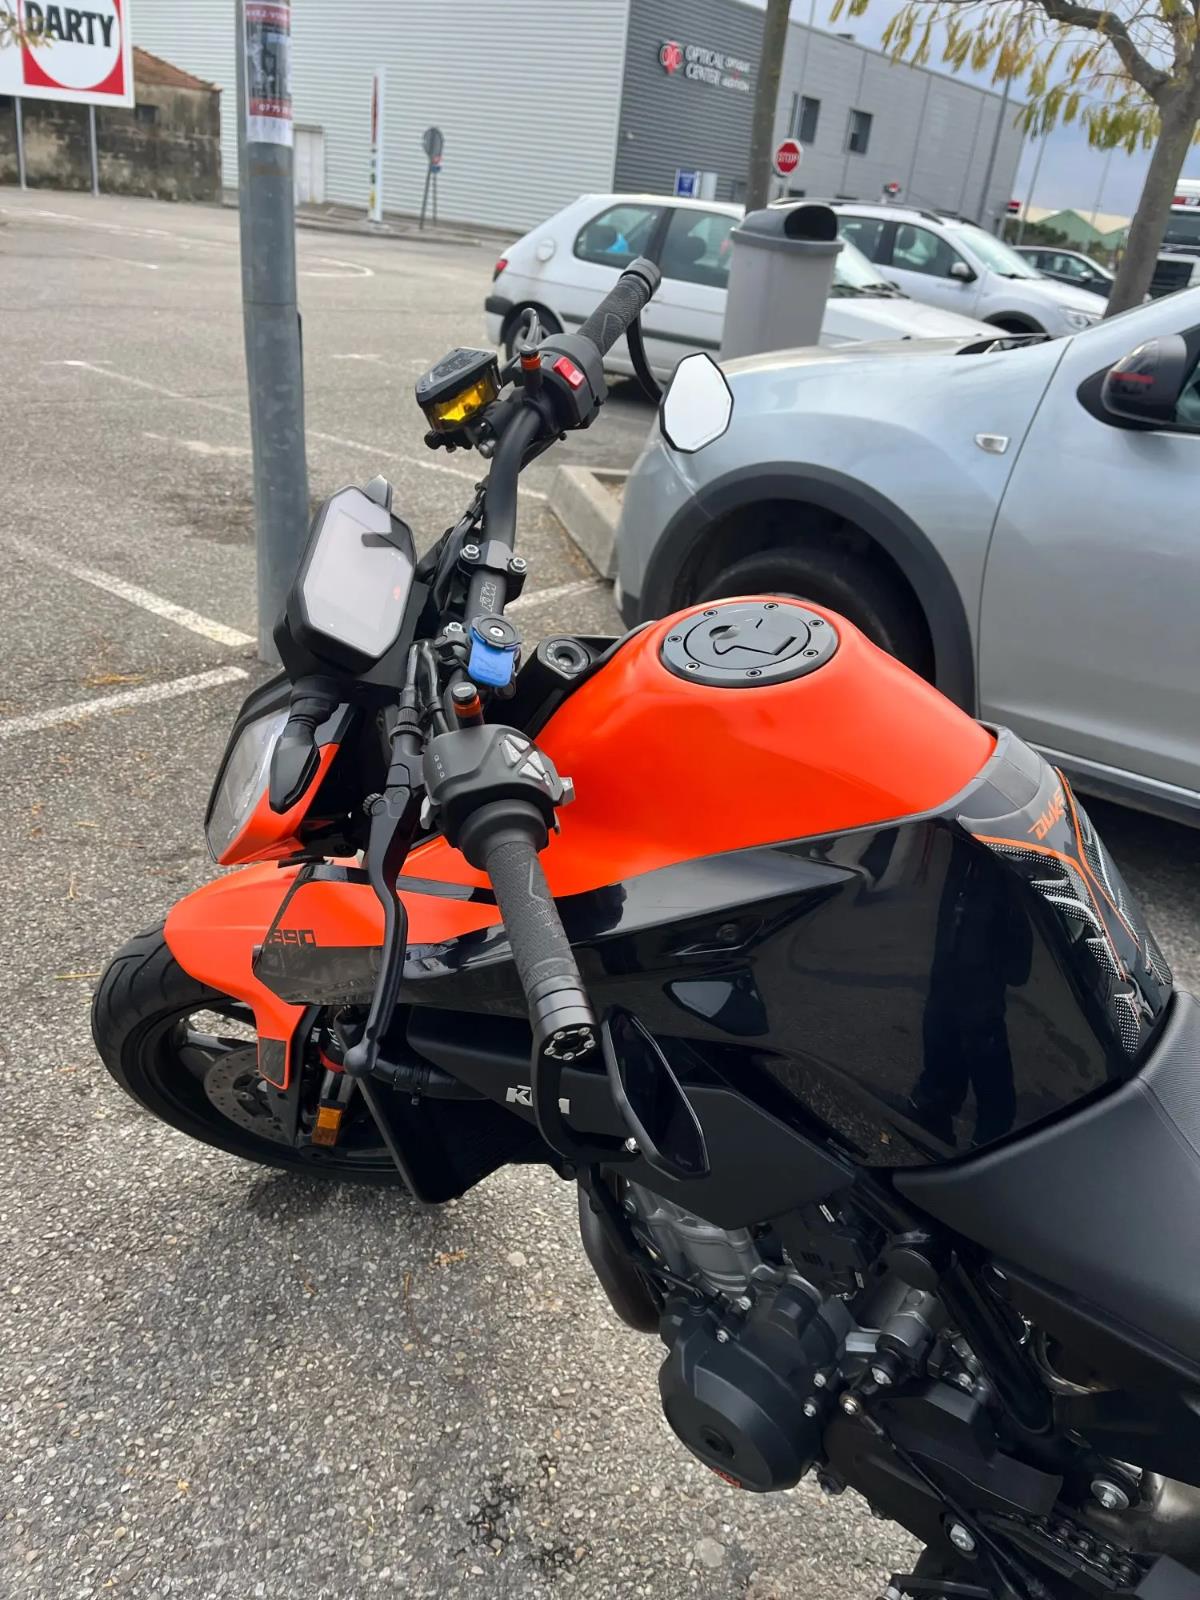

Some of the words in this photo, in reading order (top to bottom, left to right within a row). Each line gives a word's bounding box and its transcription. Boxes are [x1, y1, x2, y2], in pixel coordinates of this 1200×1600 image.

[24, 1, 114, 48] DARTY
[685, 63, 721, 87] CENTER
[776, 152, 800, 163] STOP
[268, 928, 317, 948] 890
